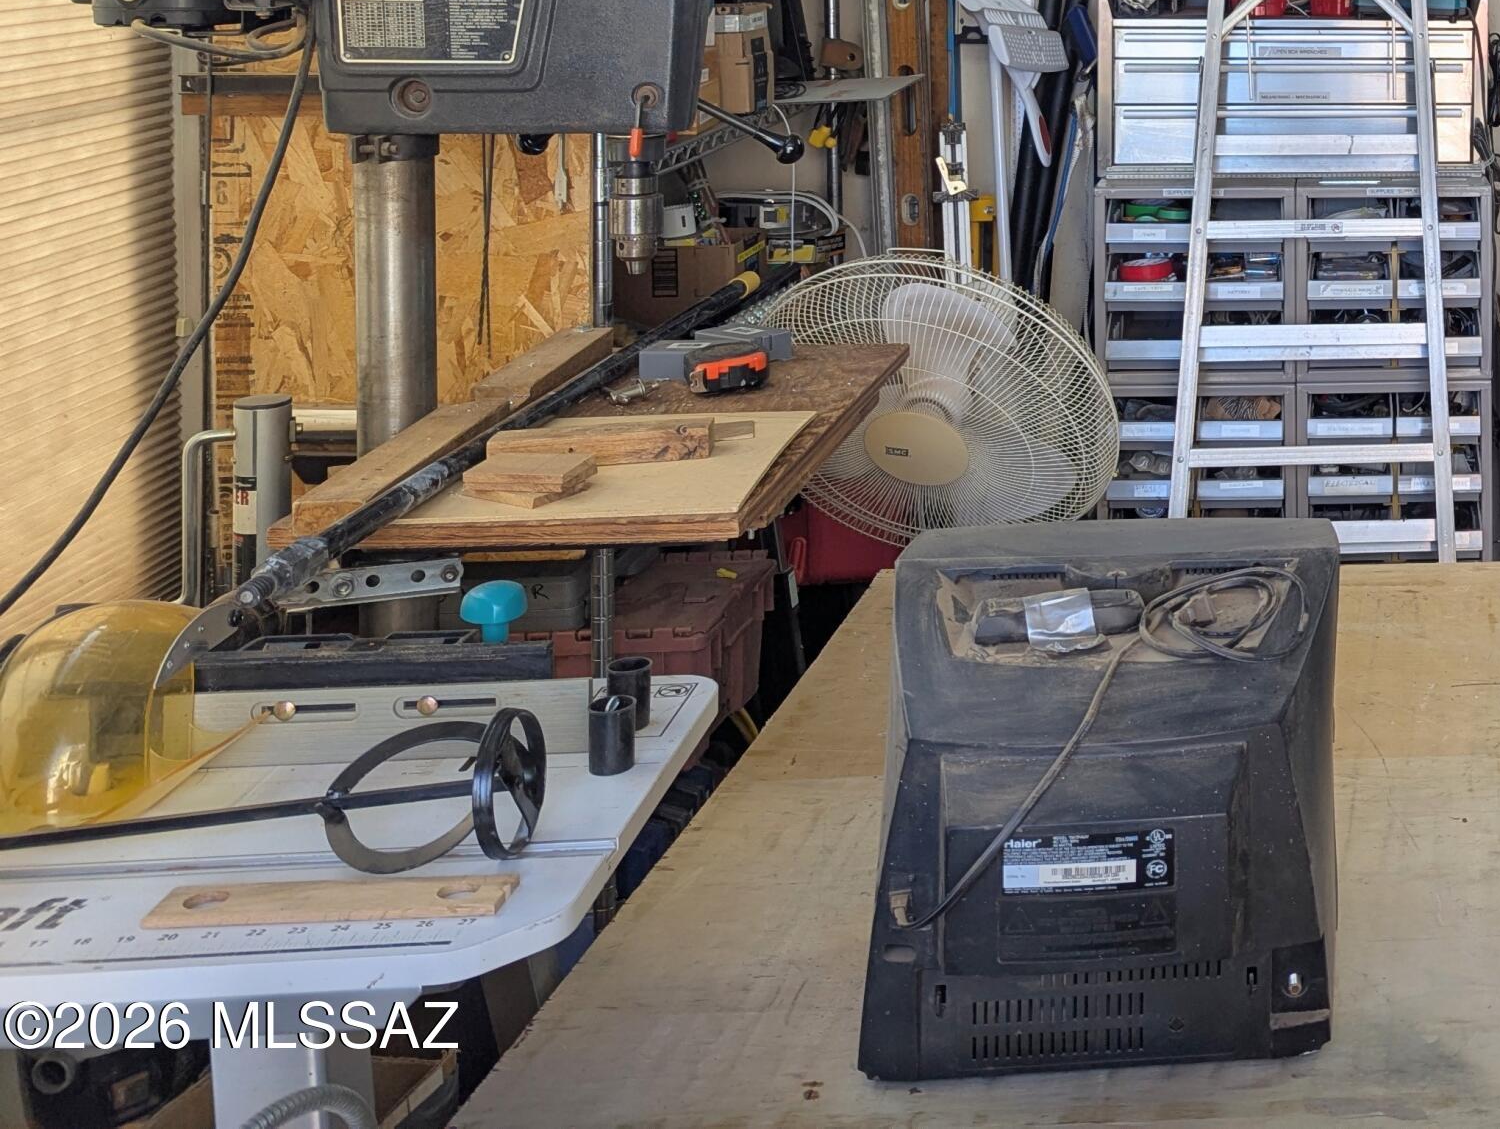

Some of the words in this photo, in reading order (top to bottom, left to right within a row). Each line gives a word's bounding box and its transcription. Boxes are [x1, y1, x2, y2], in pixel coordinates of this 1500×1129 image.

[1003, 838, 1038, 849] Haier
[372, 922, 393, 930] 25
[415, 920, 435, 928] 26
[457, 918, 477, 926] 27
[288, 926, 308, 934] 23
[330, 924, 351, 932] 24
[200, 931, 220, 939] 21
[245, 928, 267, 937] 22
[73, 937, 92, 946] 18
[116, 935, 136, 943] 19
[157, 933, 178, 942] 20
[29, 940, 49, 948] 17
